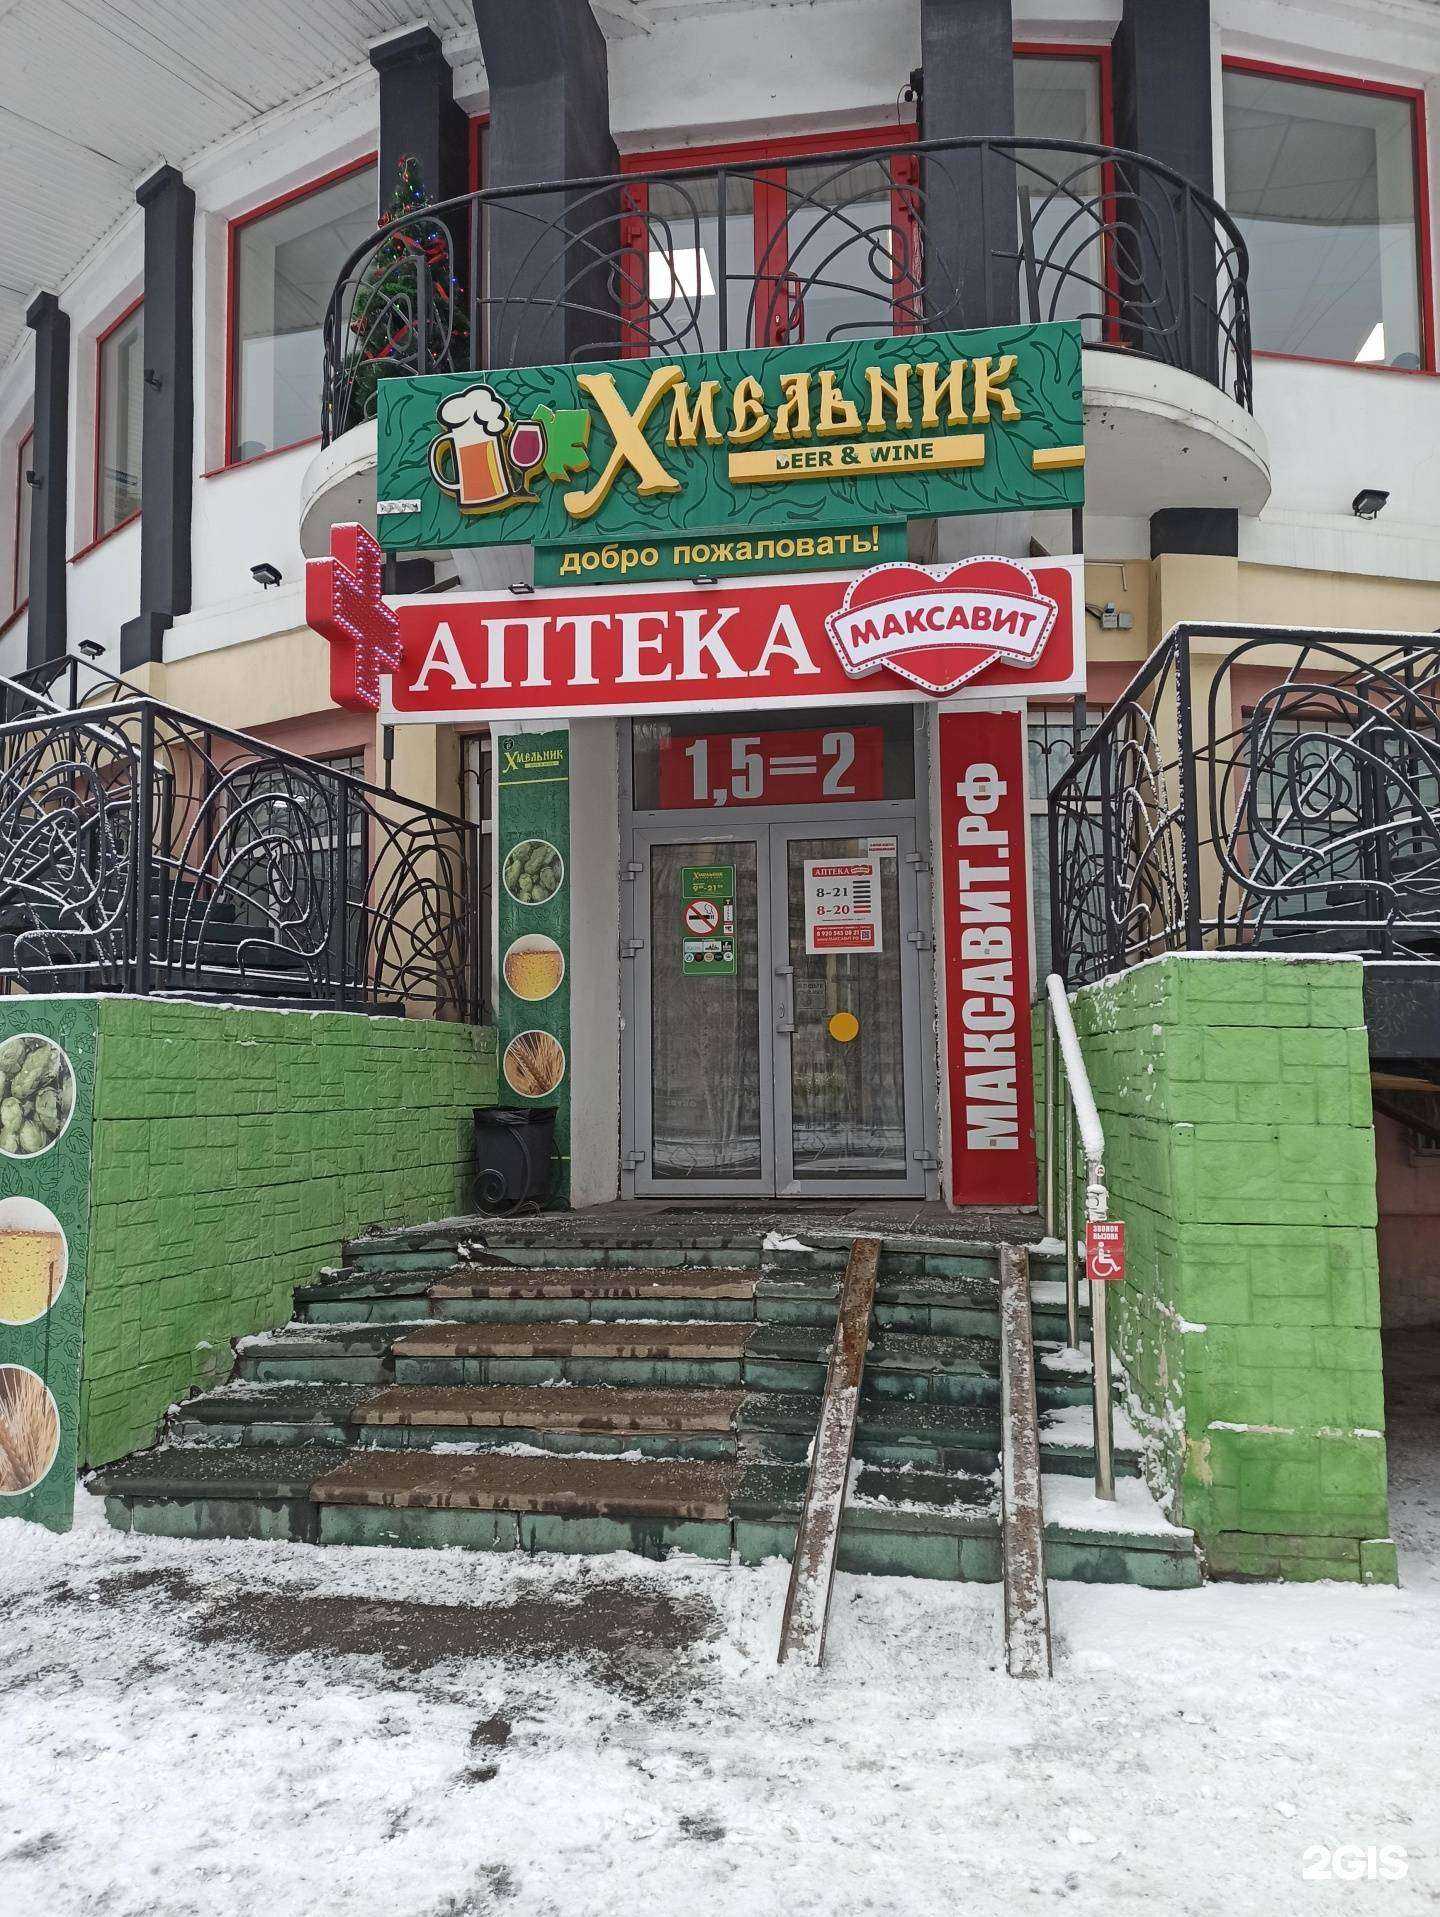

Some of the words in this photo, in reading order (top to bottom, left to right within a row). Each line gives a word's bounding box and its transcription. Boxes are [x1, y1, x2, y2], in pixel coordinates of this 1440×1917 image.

[841, 446, 861, 465] &
[869, 442, 934, 463] WINE
[560, 543, 659, 575] добро
[673, 526, 881, 566] пожаловать!
[409, 604, 820, 692] АПТЕКА
[850, 605, 1039, 651] МАКСАВИТ
[686, 732, 855, 806] 1,5=2
[814, 868, 850, 876] АПТЕКА
[816, 887, 848, 897] 8-21
[817, 905, 850, 915] 8-20
[957, 763, 1019, 1150] МАКСАВИТ.РФ
